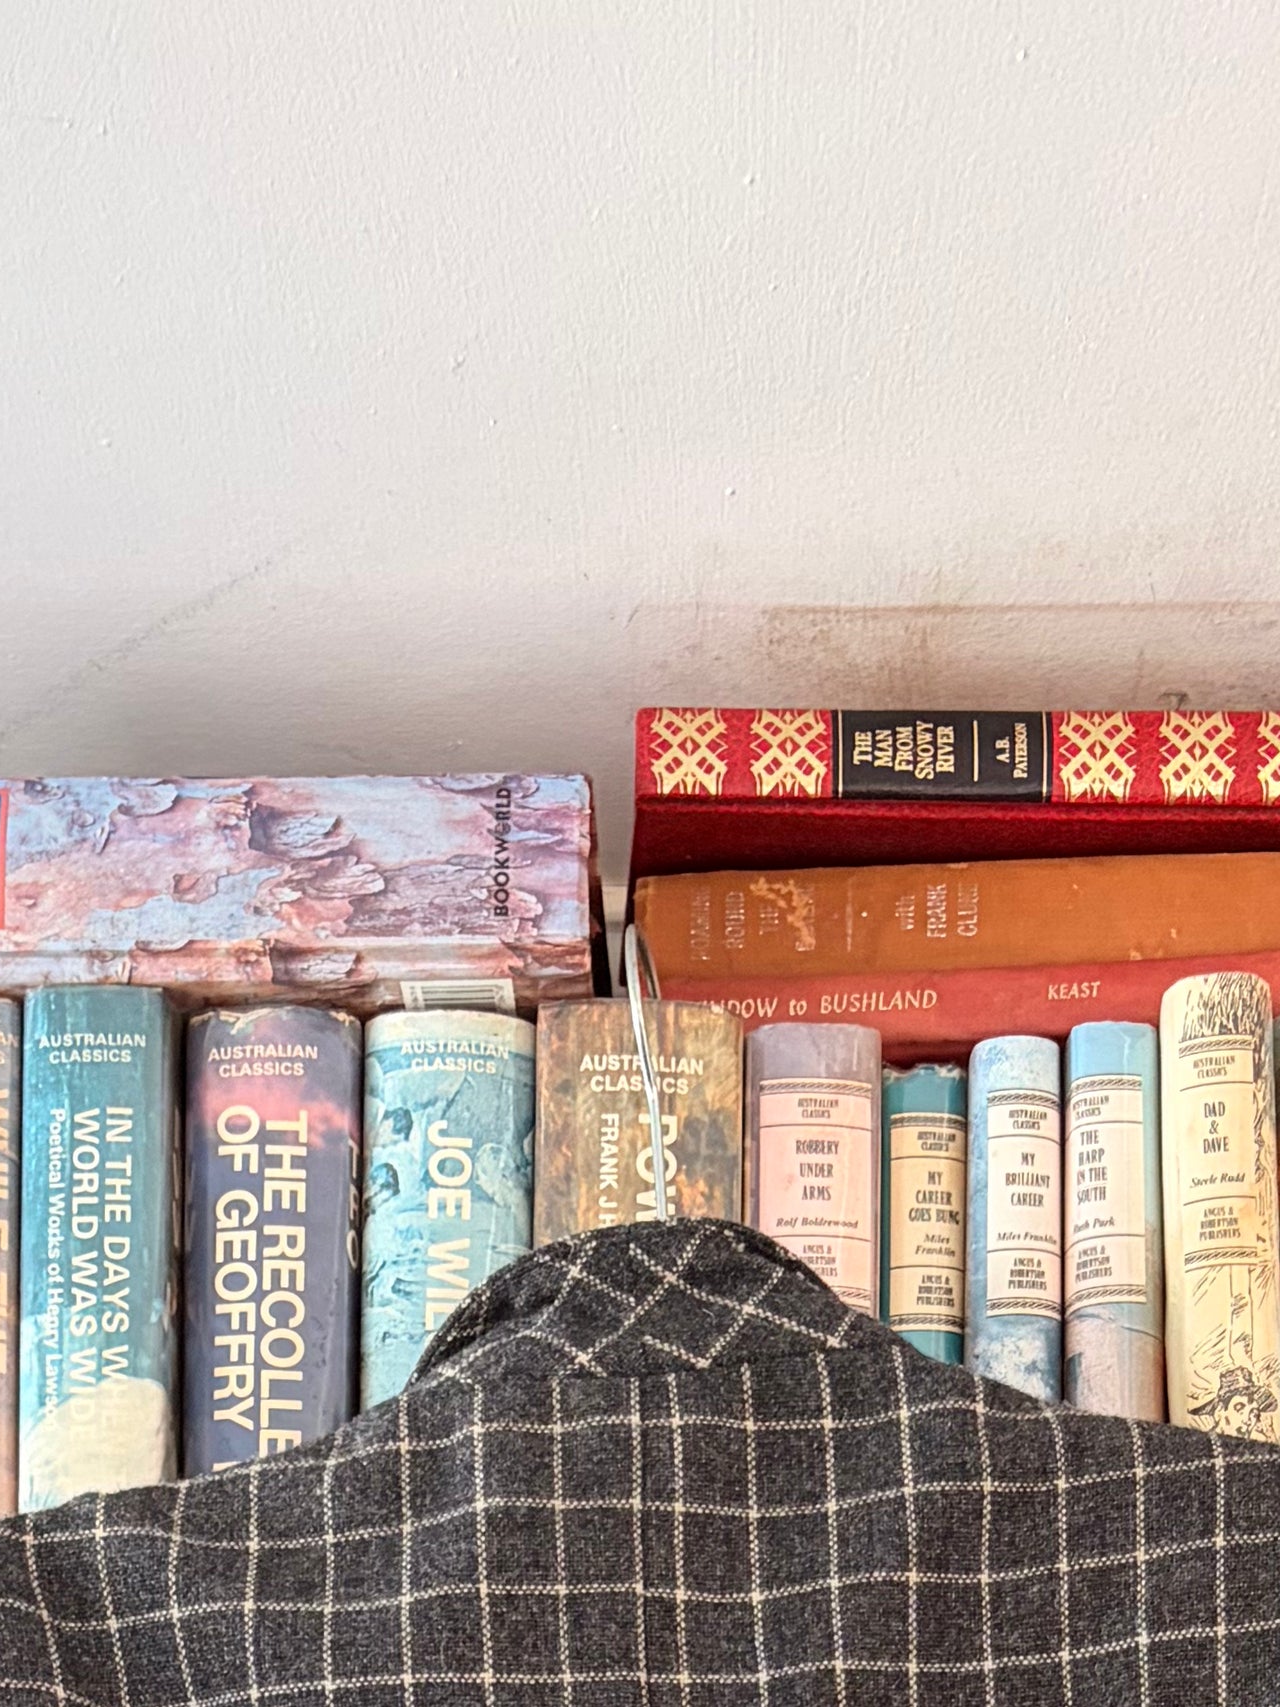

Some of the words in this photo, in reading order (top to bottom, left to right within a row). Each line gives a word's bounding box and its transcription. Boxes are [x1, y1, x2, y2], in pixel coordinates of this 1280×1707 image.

[874, 729, 893, 767] MAN
[894, 726, 914, 772] FROM
[915, 720, 935, 780] SNOWY
[935, 725, 956, 773] RIVER
[494, 788, 511, 917] BOOKWORLD
[1047, 981, 1101, 1001] KEAST
[39, 1033, 147, 1049] AUSTRALIAN
[48, 1048, 133, 1064] CLASSICS
[207, 1045, 318, 1062] AUSTRALIAN
[218, 1062, 305, 1078] CLASSICS
[1203, 1101, 1227, 1120] DAD
[215, 1105, 260, 1174] OF
[795, 1139, 840, 1156] ROBBERY
[1202, 1136, 1231, 1154] DAVE
[263, 1109, 308, 1214] THE
[799, 1163, 834, 1179] UNDER
[801, 1184, 832, 1202] ARMS
[212, 1192, 259, 1432] GEOFFRY
